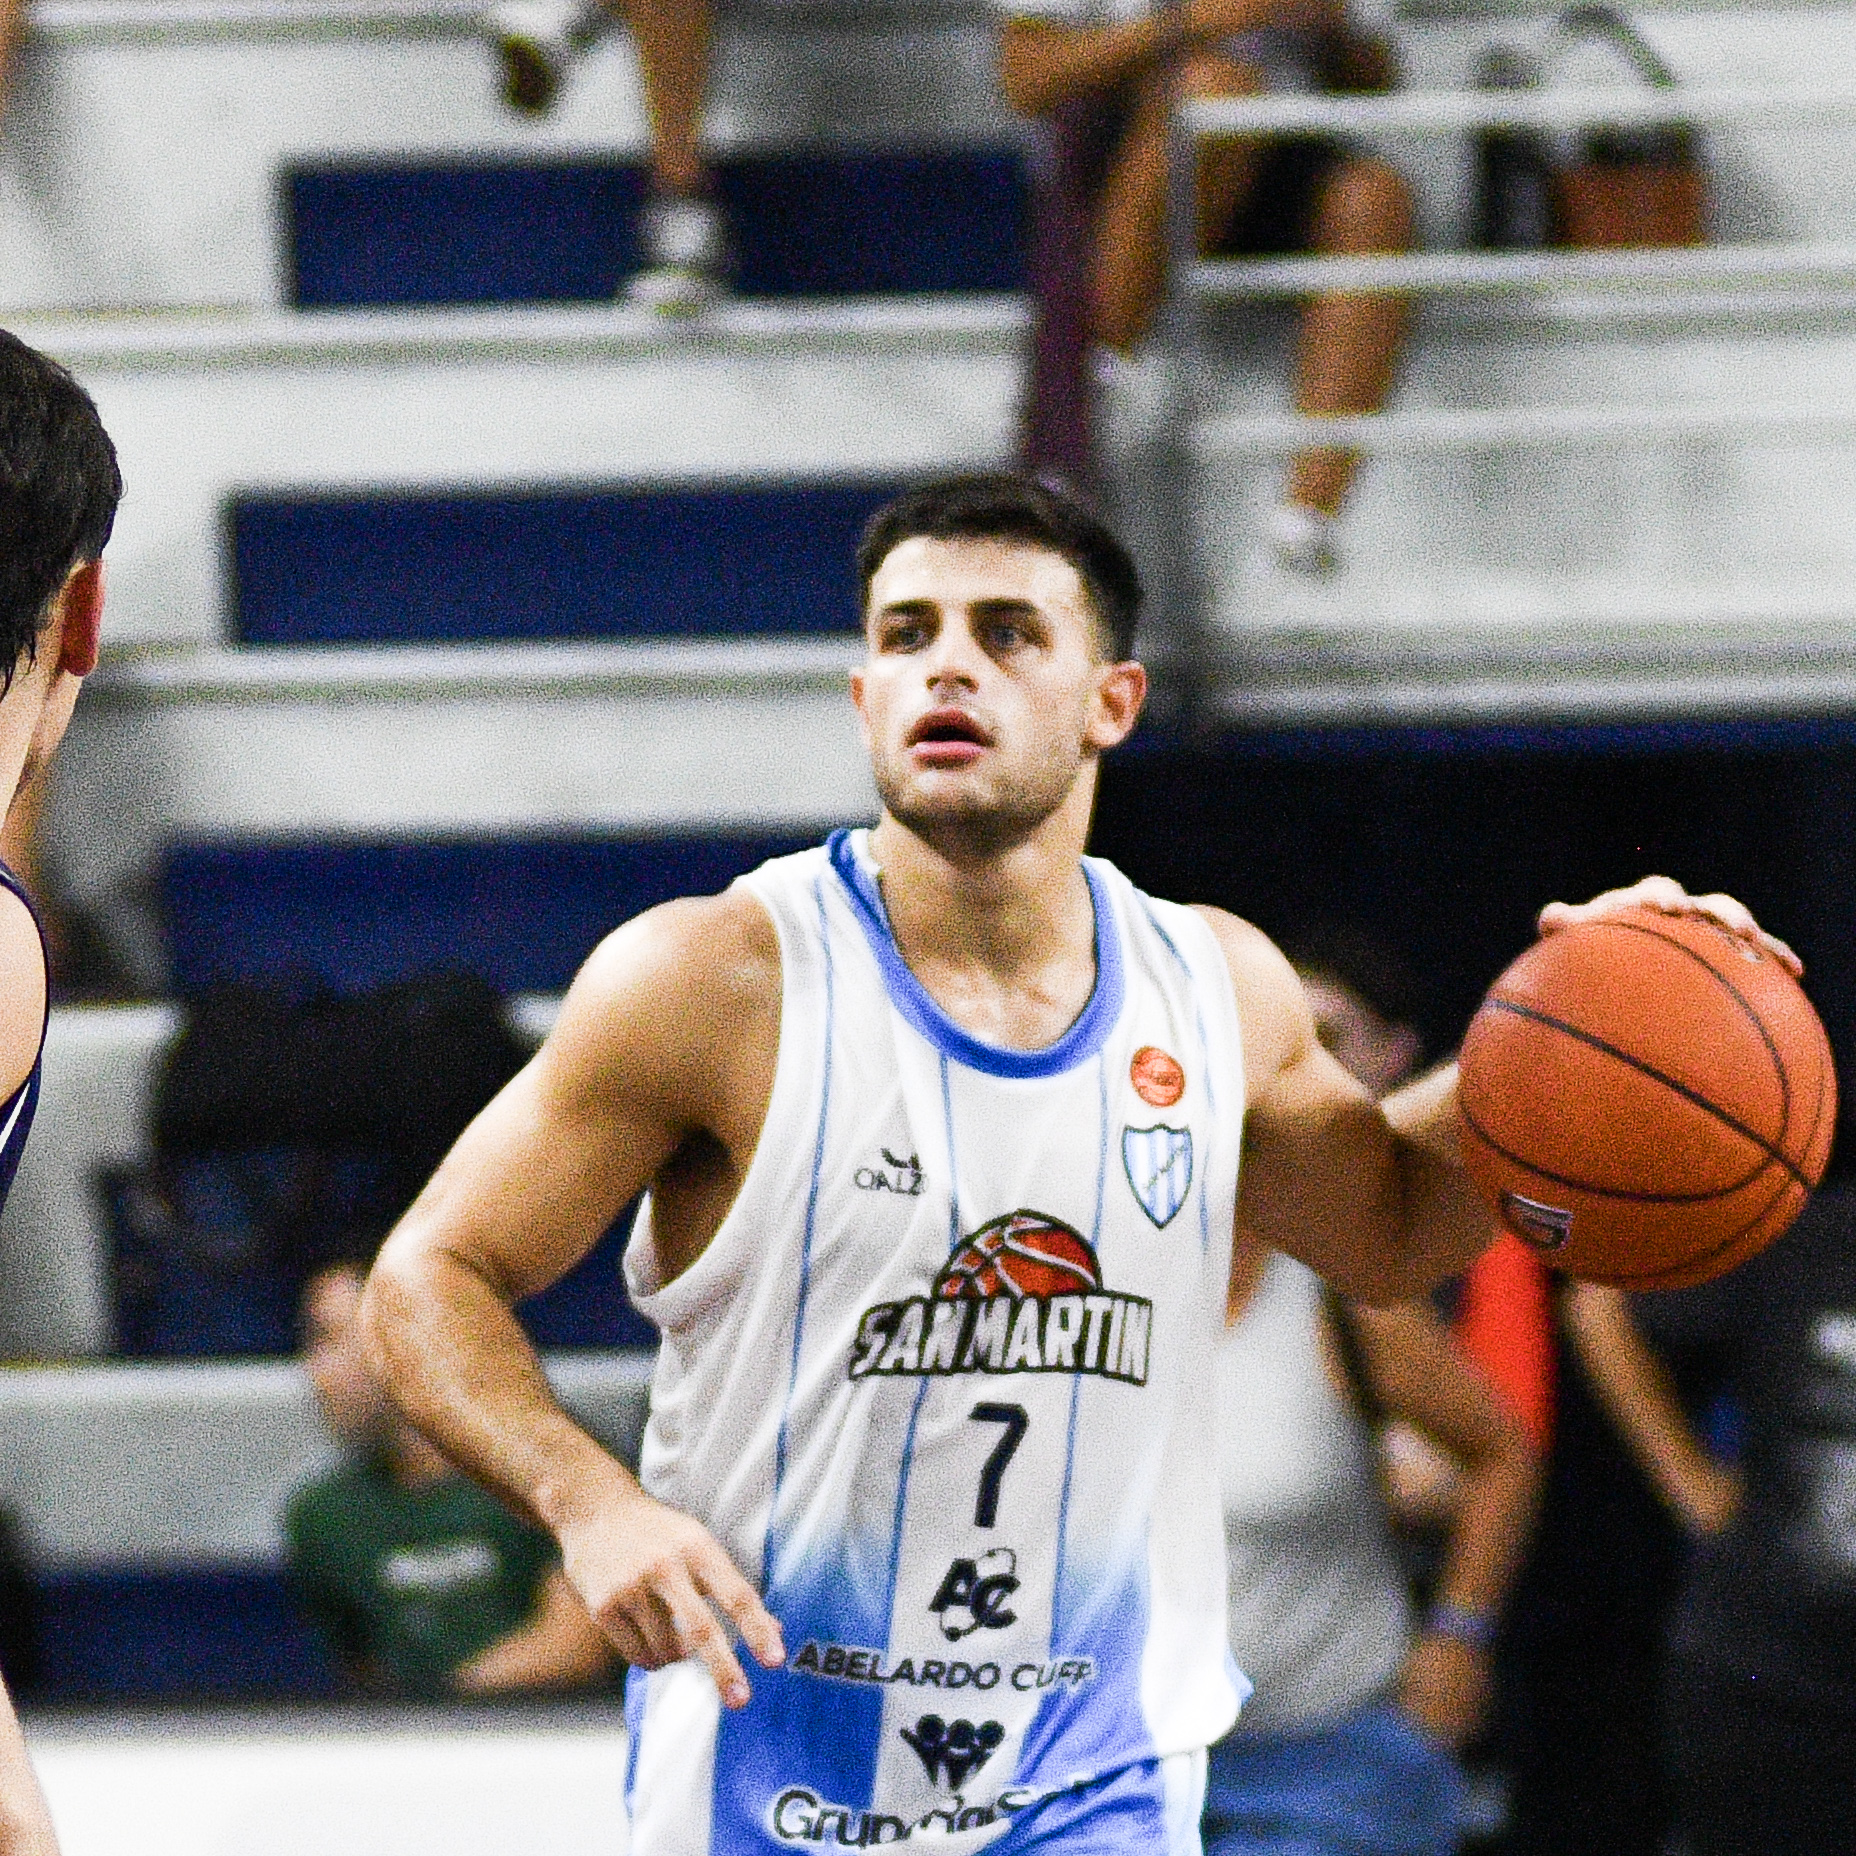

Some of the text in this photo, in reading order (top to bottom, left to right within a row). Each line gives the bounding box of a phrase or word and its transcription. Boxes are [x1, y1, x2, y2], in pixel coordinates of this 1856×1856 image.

[850, 1294, 1152, 1386] SAN MARTIN
[968, 1403, 1029, 1528] 7
[793, 1643, 1002, 1691] ABELARDO
